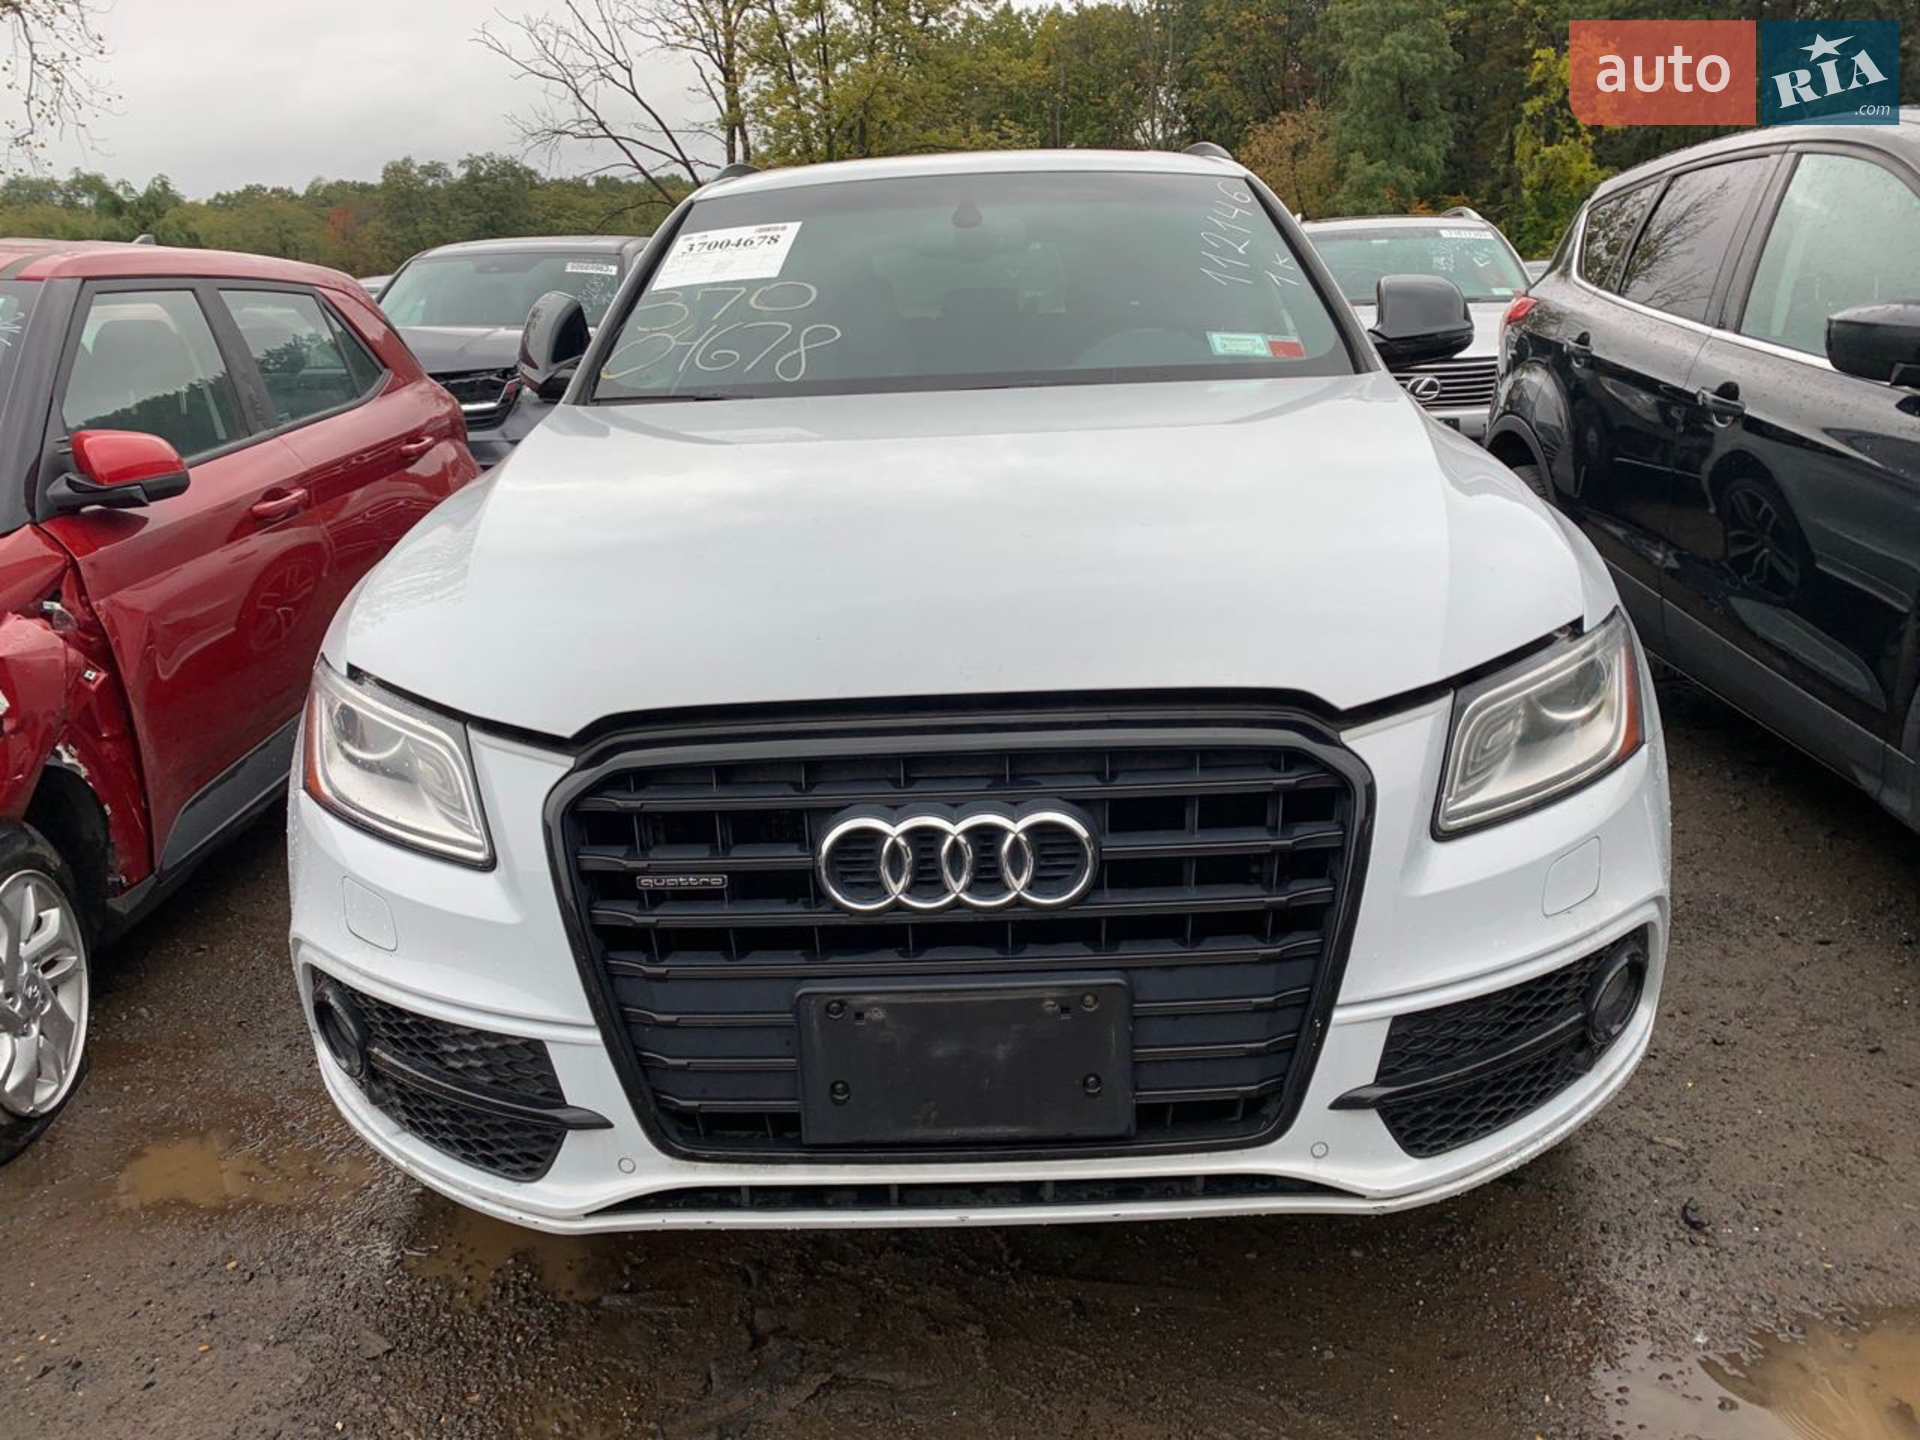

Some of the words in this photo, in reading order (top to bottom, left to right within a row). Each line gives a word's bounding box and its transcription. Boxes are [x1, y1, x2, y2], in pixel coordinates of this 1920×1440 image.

[681, 234, 781, 255] 37004678
[636, 281, 818, 332] 370
[640, 876, 723, 888] quattro
